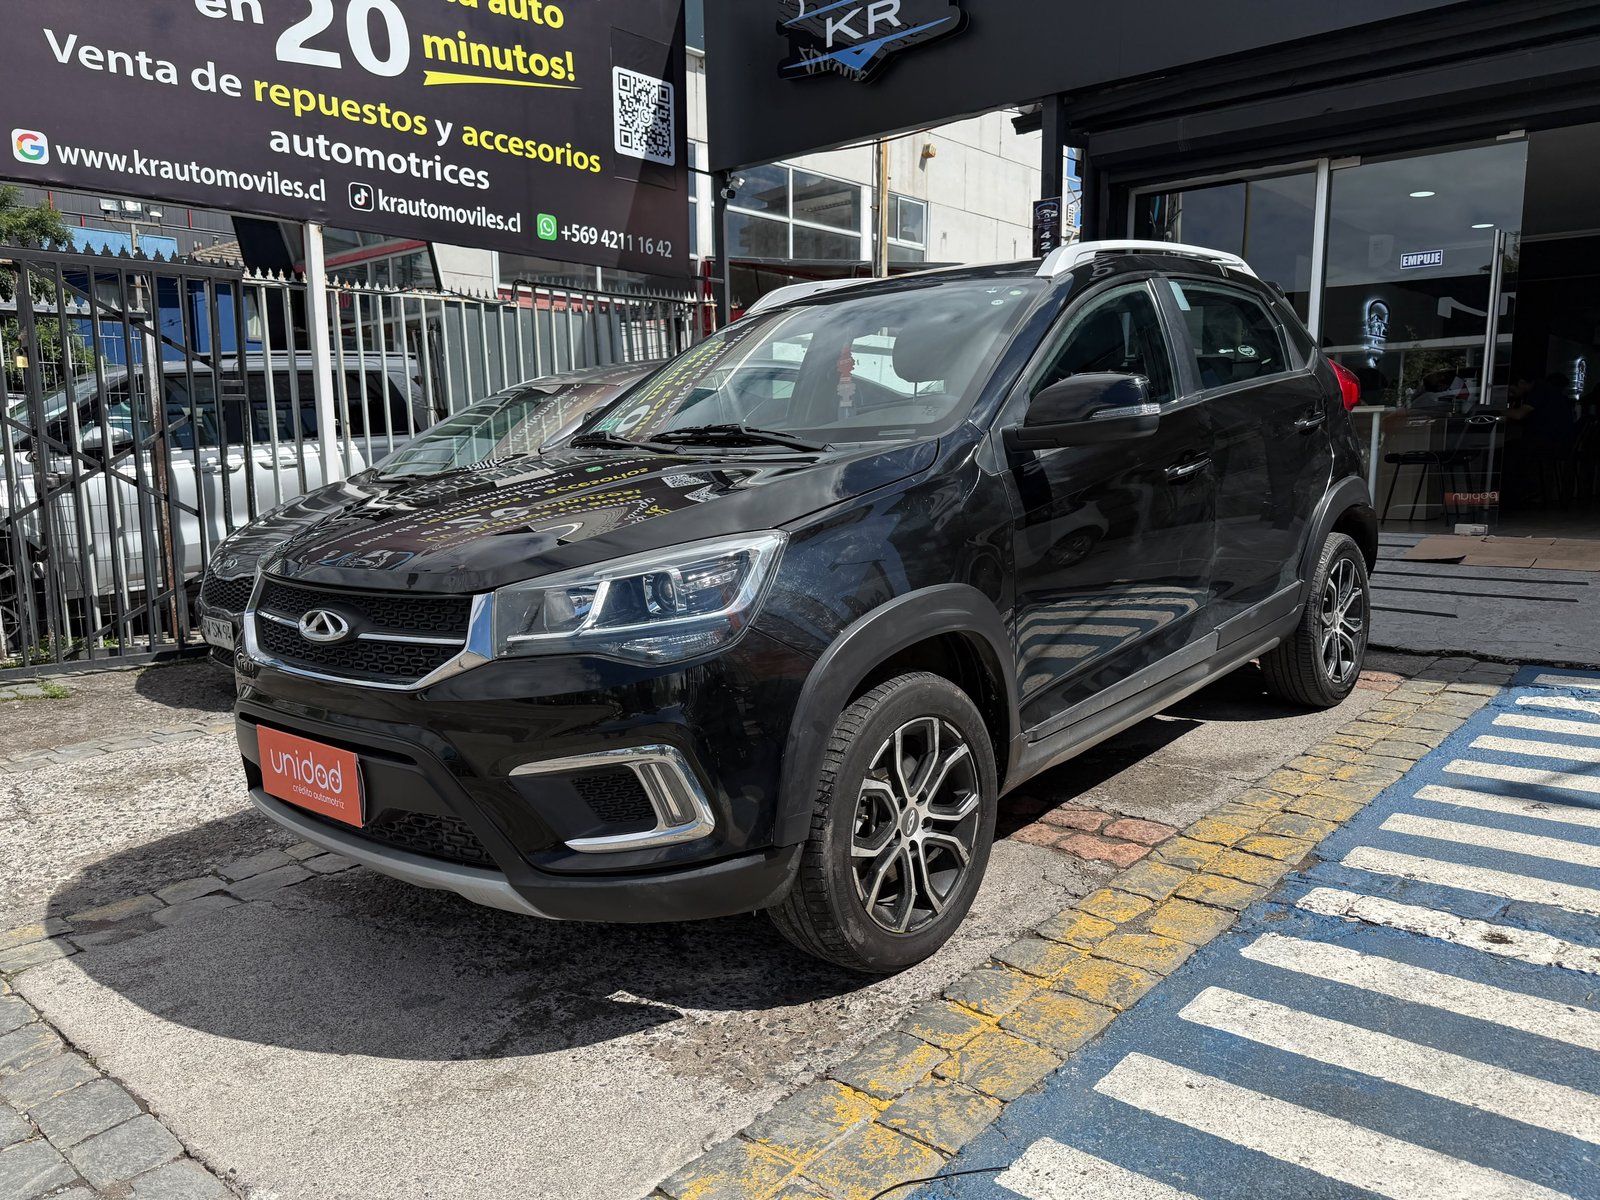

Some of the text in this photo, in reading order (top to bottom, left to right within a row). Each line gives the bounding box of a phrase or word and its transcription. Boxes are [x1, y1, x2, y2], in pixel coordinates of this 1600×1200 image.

[488, 0, 564, 28] auto
[826, 0, 902, 48] KR
[275, 0, 411, 77] 20
[422, 30, 576, 82] minutos!
[43, 28, 601, 173] Venta de repuestos y accesorios
[56, 144, 326, 202] www.krautomoviles.cl
[269, 130, 490, 190] automotrices
[378, 188, 521, 233] krautomoviles.cl
[561, 224, 672, 258] +569 4211 16 42
[1402, 252, 1441, 267] EMPUJE
[270, 748, 343, 794] unidad
[292, 784, 345, 810] crédito automotriz
